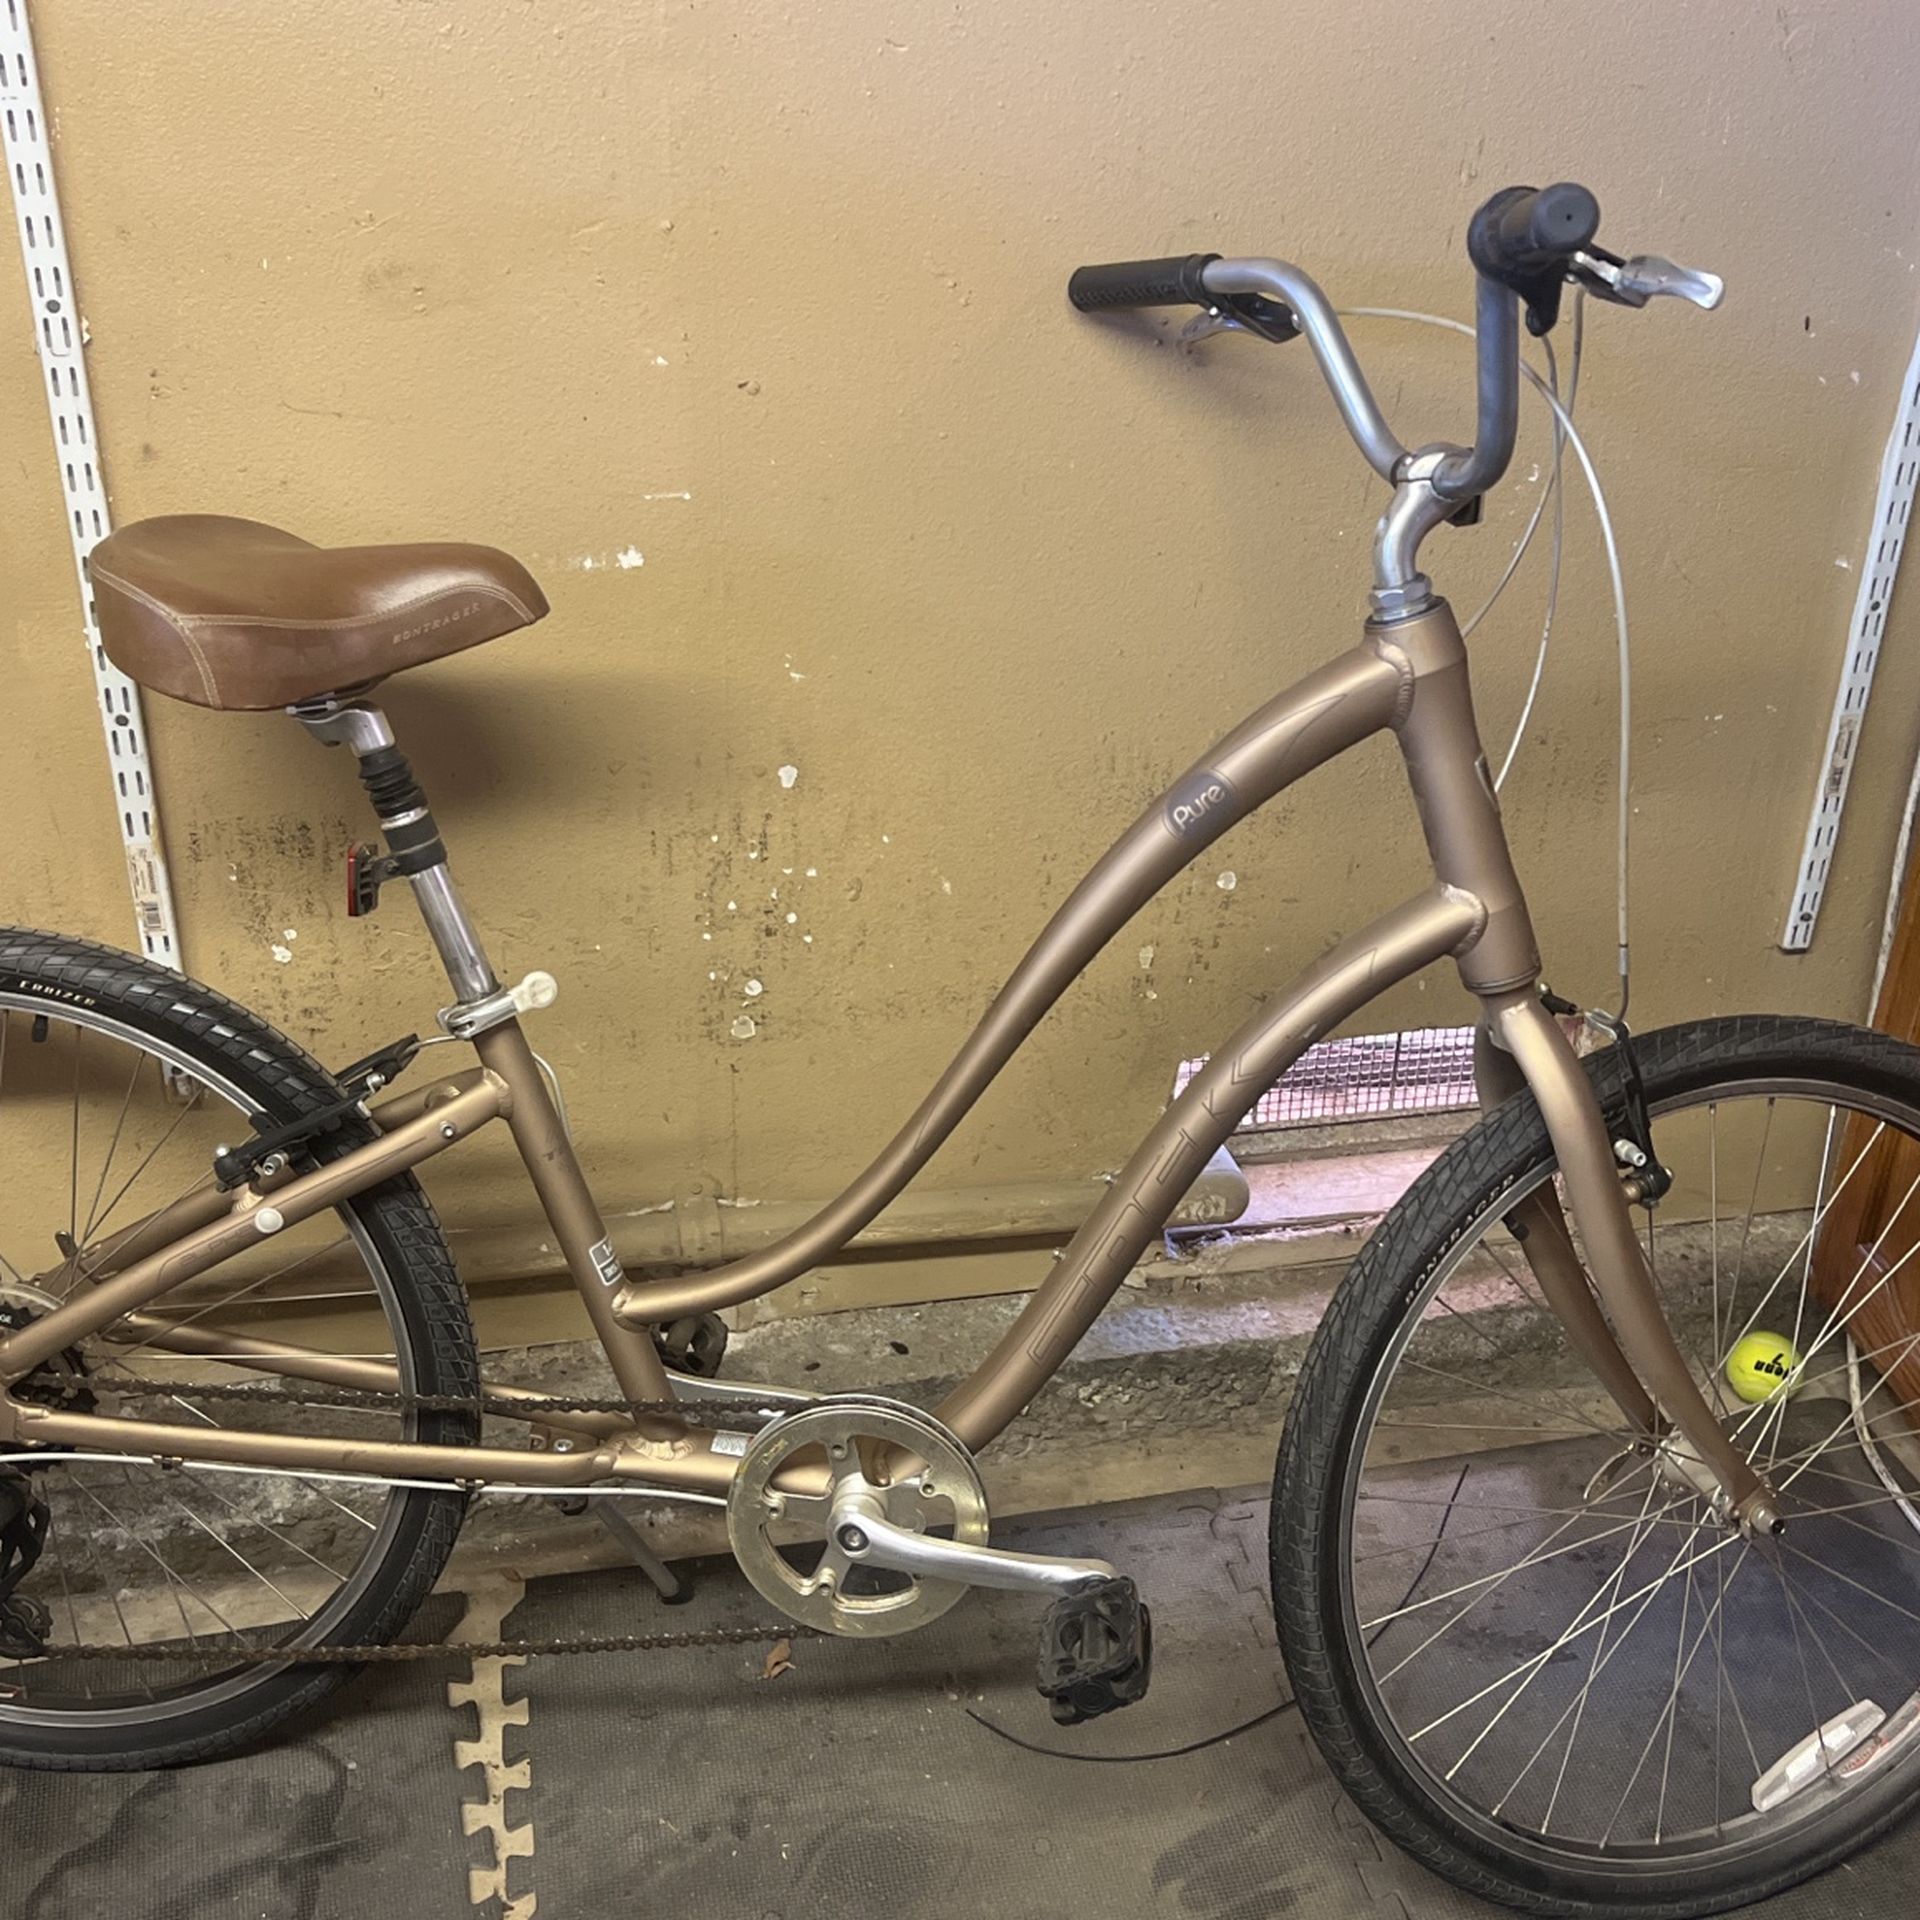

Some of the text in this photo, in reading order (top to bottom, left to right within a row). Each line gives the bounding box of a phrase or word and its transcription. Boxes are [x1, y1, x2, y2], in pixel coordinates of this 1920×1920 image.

[393, 602, 481, 645] BONTRAGER
[1173, 785, 1225, 829] Pure
[1405, 1174, 1514, 1305] BONTRAGER
